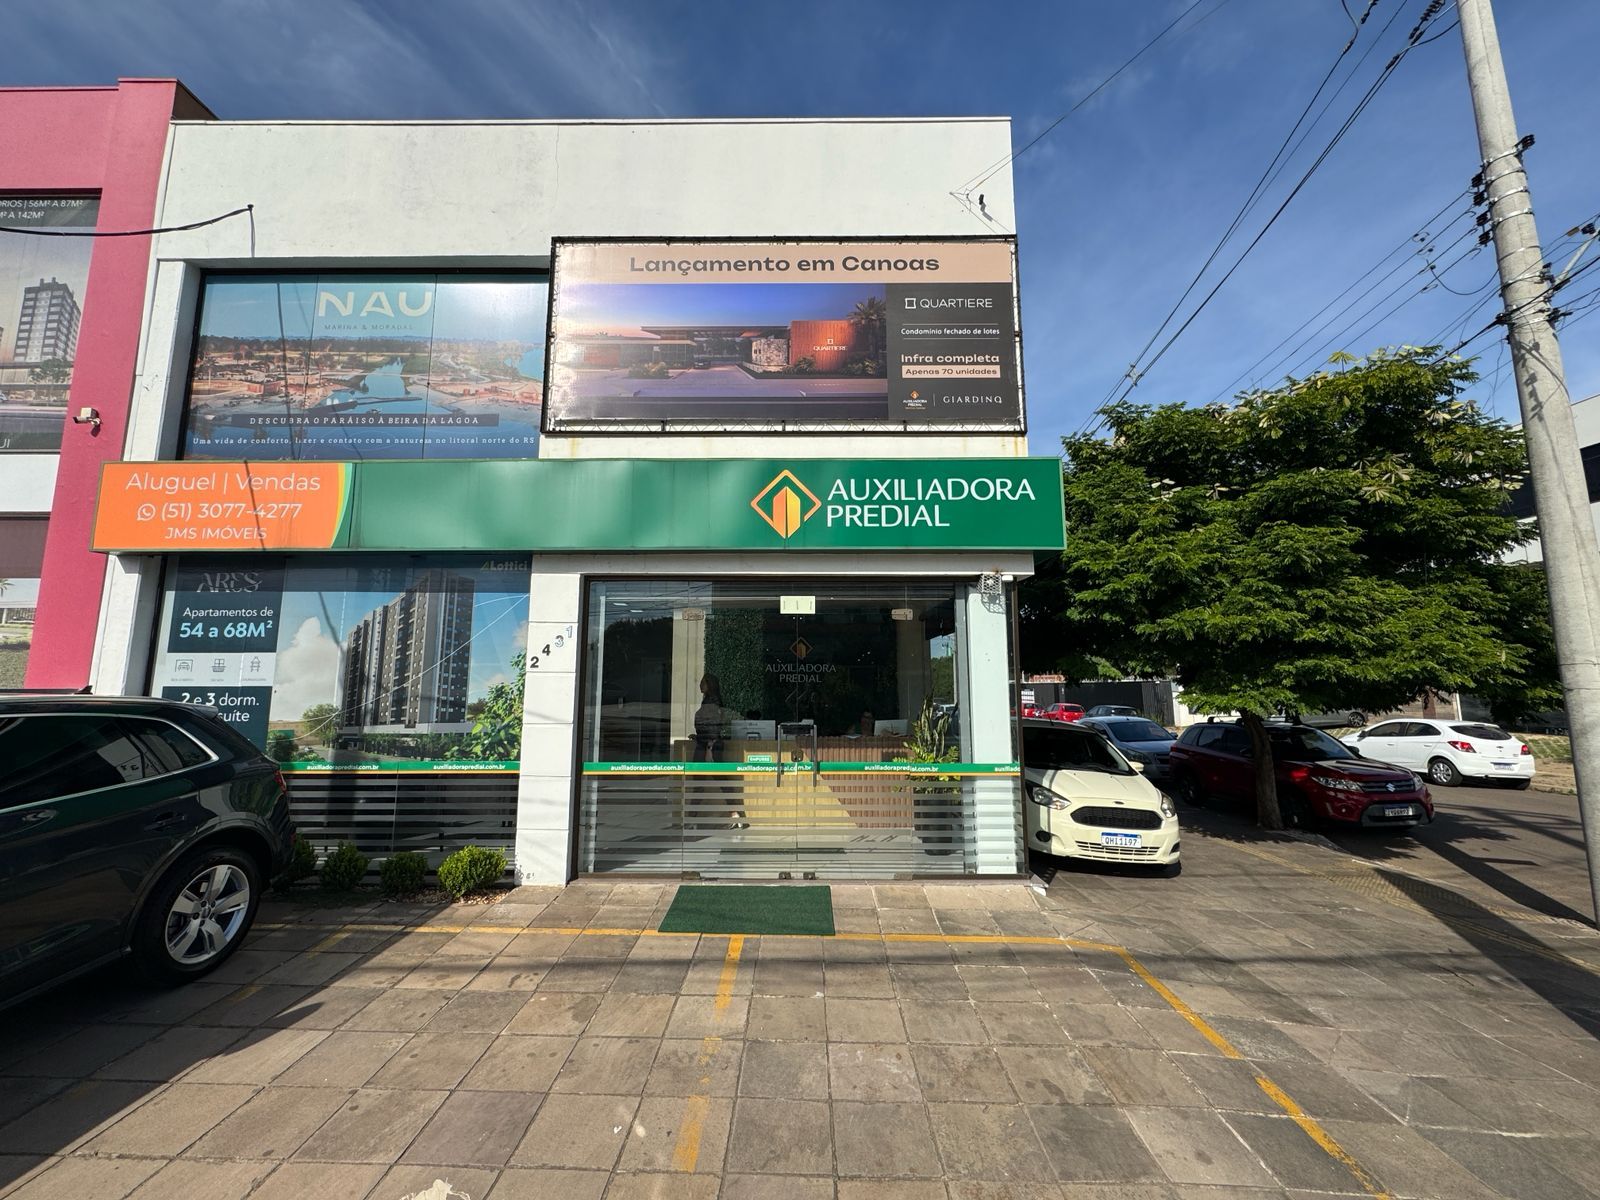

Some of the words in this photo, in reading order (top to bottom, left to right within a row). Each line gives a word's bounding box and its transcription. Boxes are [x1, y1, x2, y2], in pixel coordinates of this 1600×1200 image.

[51, 200, 59, 208] A
[630, 256, 790, 276] Lançamento
[796, 259, 835, 272] em
[841, 256, 940, 272] Canoas
[318, 291, 433, 317] NAU
[919, 298, 993, 309] QUARTIERE
[901, 353, 933, 363] Infra
[936, 353, 1000, 364] completa
[905, 368, 940, 376] Apenas
[193, 437, 212, 445] Uma
[125, 472, 216, 495] Aluguel
[236, 472, 321, 491] Vendas
[827, 478, 1036, 501] AUXILIADORA
[161, 503, 192, 521] (51)
[197, 503, 303, 519] 3077-4277
[826, 504, 950, 528] PREDIAL
[164, 527, 197, 540] JMS
[201, 525, 268, 540] IMÓVEIS
[182, 607, 258, 619] Apartamentos
[259, 606, 274, 617] de
[180, 622, 204, 638] 54
[208, 626, 219, 638] a
[223, 620, 273, 638] 68M²
[765, 663, 837, 672] AUXILADORA
[779, 673, 823, 683] PREDIAL
[181, 692, 191, 703] 2
[193, 696, 202, 704] e
[205, 692, 216, 706] 3
[218, 692, 260, 706] dorm.
[306, 764, 379, 772] auxiliadorapredial.com.br
[432, 763, 506, 771] auxiliadorapredial.com.br
[610, 764, 684, 772] auxiliadorapredial.com.br
[736, 764, 812, 772] auxiliadorapreal.com.br
